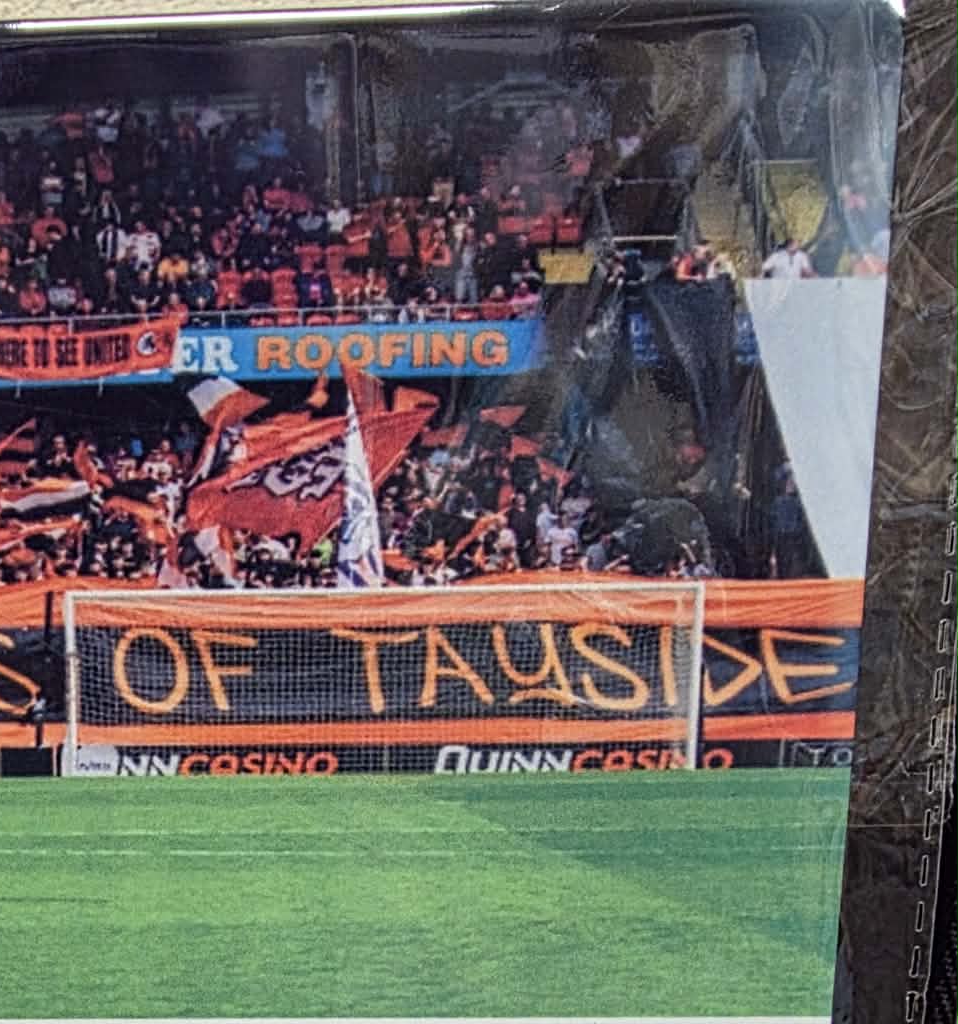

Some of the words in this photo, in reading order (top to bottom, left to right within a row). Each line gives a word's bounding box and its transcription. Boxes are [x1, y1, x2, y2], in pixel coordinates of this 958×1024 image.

[256, 330, 509, 370] ROOFING
[114, 627, 257, 714] OF
[330, 623, 853, 714] TAYSIDE
